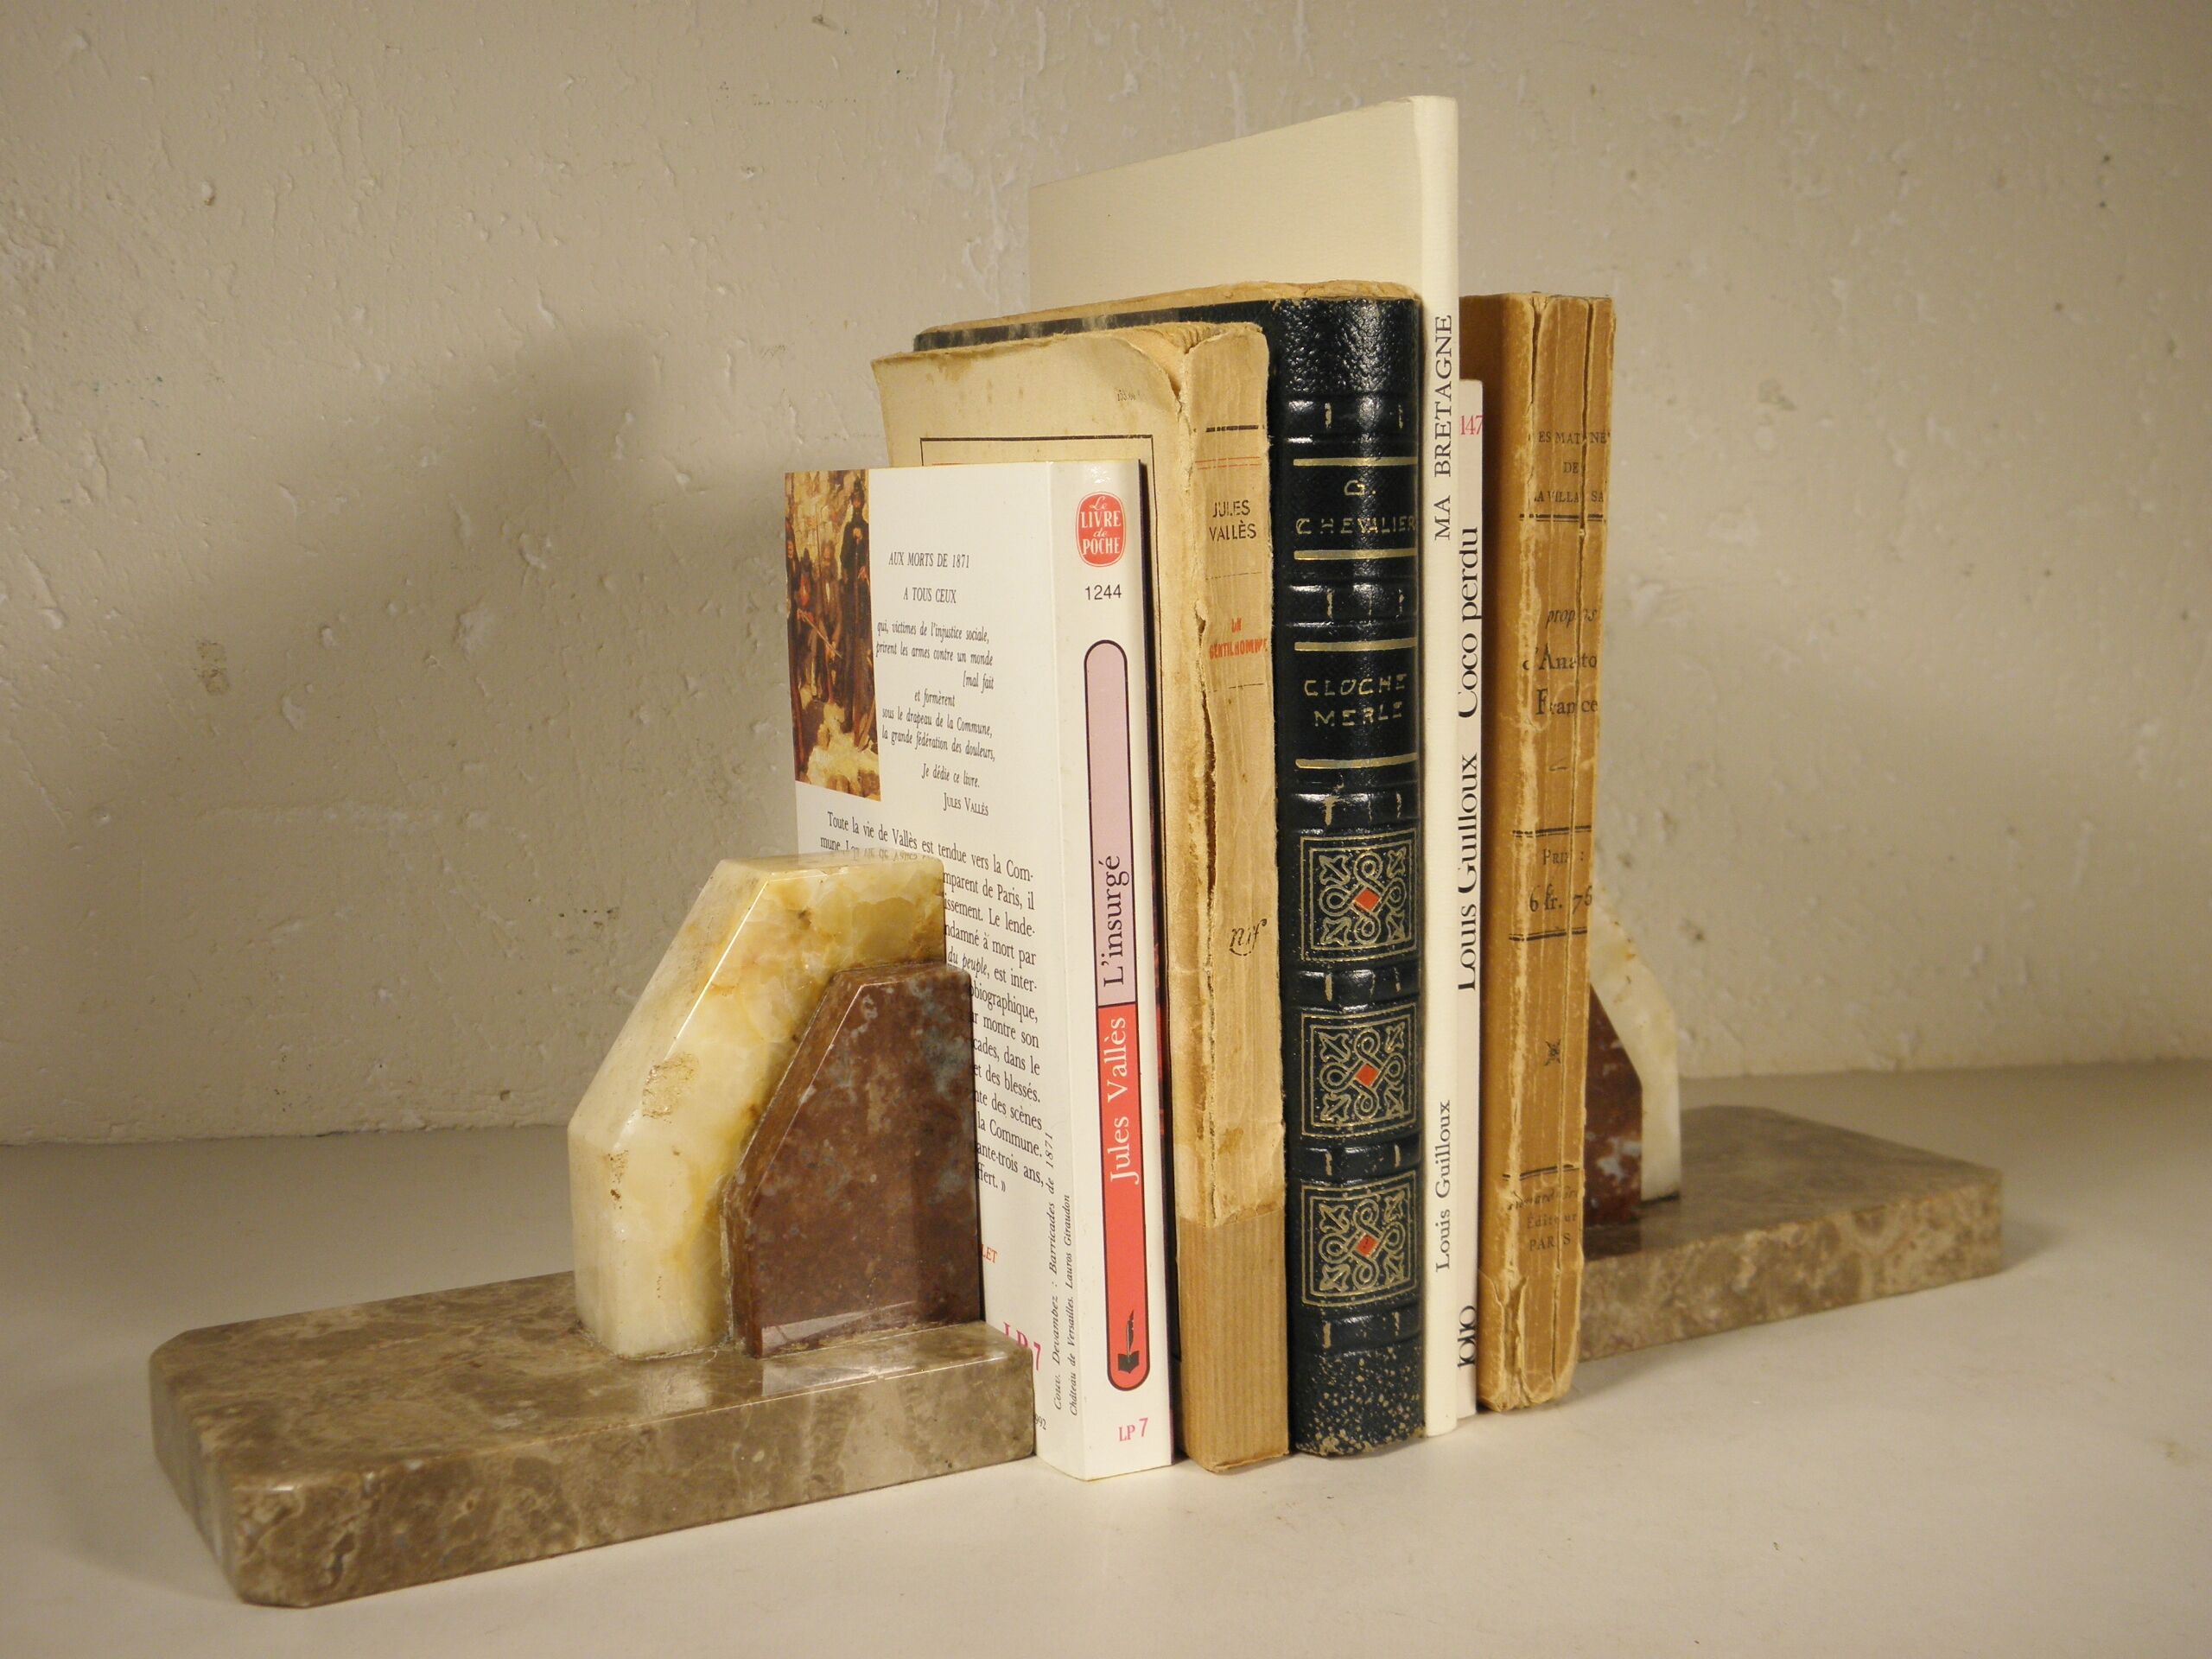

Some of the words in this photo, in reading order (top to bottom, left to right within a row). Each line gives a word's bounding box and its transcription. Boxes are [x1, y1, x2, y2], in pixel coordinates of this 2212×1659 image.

[1434, 315, 1452, 478] BRETAGNE
[1563, 462, 1579, 474] DE
[1090, 495, 1107, 510] Le
[1212, 499, 1251, 518] JULES
[1548, 491, 1580, 502] VILLA
[1081, 511, 1122, 529] LIVRE
[1093, 527, 1108, 538] de
[1209, 520, 1257, 542] VALLÈS
[1296, 516, 1416, 534] CHEVALIER
[1434, 494, 1451, 541] MA
[888, 551, 904, 566] AUX
[907, 552, 933, 567] MORTS
[938, 554, 948, 568] DE
[952, 555, 969, 569] 1871
[1082, 537, 1121, 556] POCHE
[1459, 527, 1482, 622] perdu
[903, 588, 908, 600] A
[912, 588, 931, 602] TOUS
[935, 589, 957, 604] CEUX
[1084, 584, 1122, 601] 1244
[877, 620, 888, 637] qui,
[892, 620, 917, 635] victimes
[919, 621, 927, 636] de
[931, 621, 963, 643] l'injustice
[965, 626, 989, 644] sociale,
[875, 642, 897, 658] prirent
[911, 646, 930, 659] armes
[933, 647, 953, 663] contre
[957, 652, 967, 664] un
[970, 650, 993, 666] monde
[981, 673, 994, 693] fait
[1305, 673, 1407, 696] CLOCHE
[1458, 632, 1478, 719] Coco
[914, 690, 921, 702] et
[922, 689, 956, 708] formèrent
[1313, 701, 1402, 727] MERLE
[882, 708, 894, 720] sous
[897, 706, 903, 721] le
[906, 708, 932, 729] drapeau
[935, 715, 944, 728] de
[947, 715, 954, 730] la
[957, 717, 993, 739] Commune,
[881, 725, 888, 740] la
[891, 728, 912, 746] grande
[914, 731, 948, 751] fédération
[951, 737, 962, 753] des
[964, 740, 995, 762] douleurs,
[921, 763, 930, 779] Je
[932, 763, 950, 782] dédie
[953, 772, 960, 784] ce
[963, 770, 980, 788] livre.
[1458, 753, 1478, 893] Guilloux
[827, 810, 849, 831] Toute
[852, 817, 860, 835] la
[863, 821, 874, 838] vie
[878, 823, 888, 842] de
[892, 828, 918, 850] Vallès
[921, 839, 933, 855] est
[938, 842, 967, 864] tendue
[970, 852, 989, 870] vers
[993, 854, 1001, 874] la
[1006, 859, 1033, 882] Com-
[982, 879, 994, 899] de
[997, 884, 1023, 910] Paris,
[1027, 891, 1035, 910] il
[1529, 885, 1540, 912] 6
[988, 907, 1000, 927] Le
[1005, 912, 1035, 938] lende-
[1097, 855, 1129, 987] L'insurgé
[982, 932, 988, 950] à
[992, 938, 1015, 960] mort
[1018, 948, 1037, 969] par
[1458, 903, 1477, 991] Louis
[947, 945, 958, 965] du
[962, 953, 990, 980] peuple,
[994, 968, 1007, 984] est
[1010, 968, 1038, 993] inter-
[983, 1015, 1016, 1040] montre
[1021, 1031, 1039, 1049] son
[1004, 1046, 1026, 1071] dans
[1030, 1055, 1040, 1076] le
[1103, 1015, 1128, 1103] Vallès
[985, 1064, 1001, 1086] des
[1004, 1071, 1040, 1103] blessés.
[991, 1092, 1007, 1116] des
[1010, 1104, 1043, 1131] scènes
[977, 1110, 986, 1132] la
[989, 1119, 1042, 1158] Commune.
[1045, 1132, 1054, 1168] 1871
[1435, 1100, 1451, 1199] Guilloux
[1107, 1116, 1140, 1185] Jules
[1023, 1166, 1044, 1187] ans,
[1045, 1177, 1055, 1195] de
[1061, 1194, 1071, 1247] Giraudon
[1046, 1202, 1058, 1275] Barricades
[1435, 1209, 1451, 1273] Louis
[1529, 1233, 1571, 1252] PARS
[1051, 1295, 1060, 1365] Devambez
[1065, 1296, 1076, 1348] Versailles.
[1067, 1353, 1076, 1367] de
[1053, 1375, 1062, 1410] Couv.
[1068, 1372, 1077, 1417] Château
